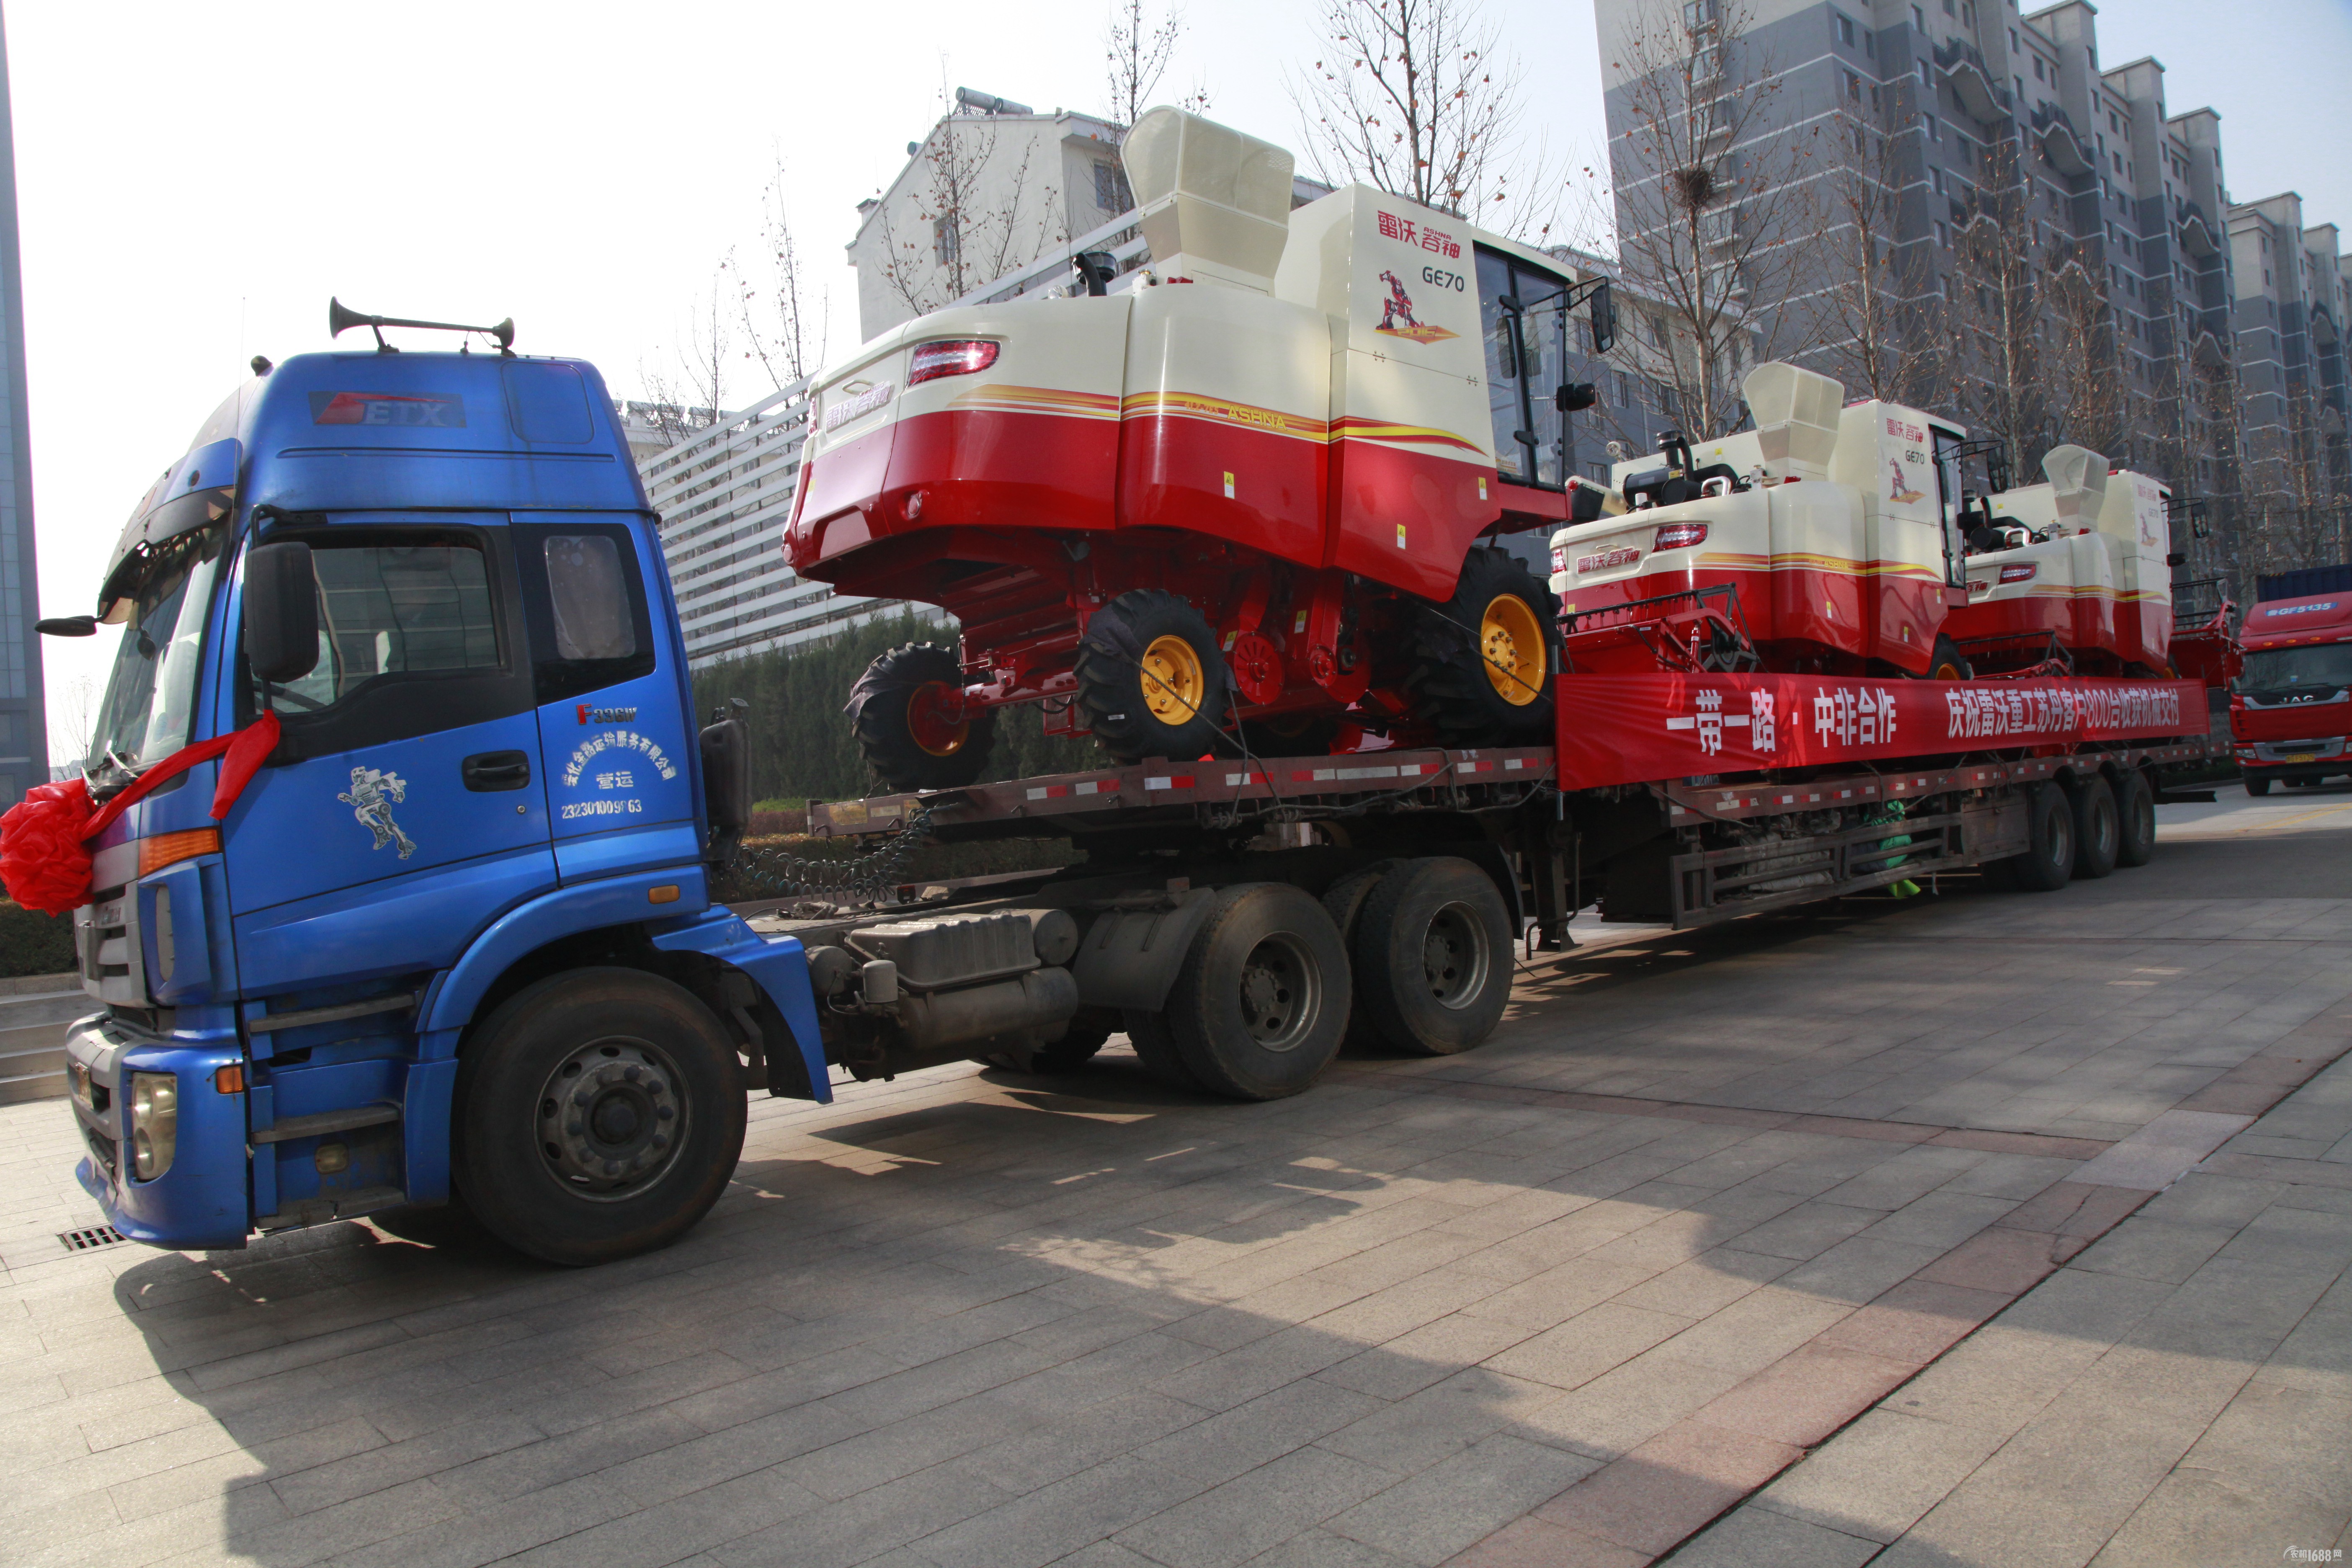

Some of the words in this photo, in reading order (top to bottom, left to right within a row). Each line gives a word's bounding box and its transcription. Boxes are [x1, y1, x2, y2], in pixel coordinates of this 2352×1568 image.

[1377, 210, 1460, 259] 雷沃谷神
[1424, 227, 1452, 240] ASHNA
[1422, 266, 1464, 292] GE70
[1228, 405, 1287, 431] ASHNA
[1886, 418, 1924, 443] 雷沃谷神
[1906, 450, 1924, 464] GE70
[1578, 549, 1640, 573] 雷沃谷神
[2279, 695, 2314, 704] JAC
[576, 704, 637, 725] F336W
[1945, 687, 2179, 739] 庆祝雷沃重工苏丹客户800台收获机械交付
[596, 771, 634, 789] 营运
